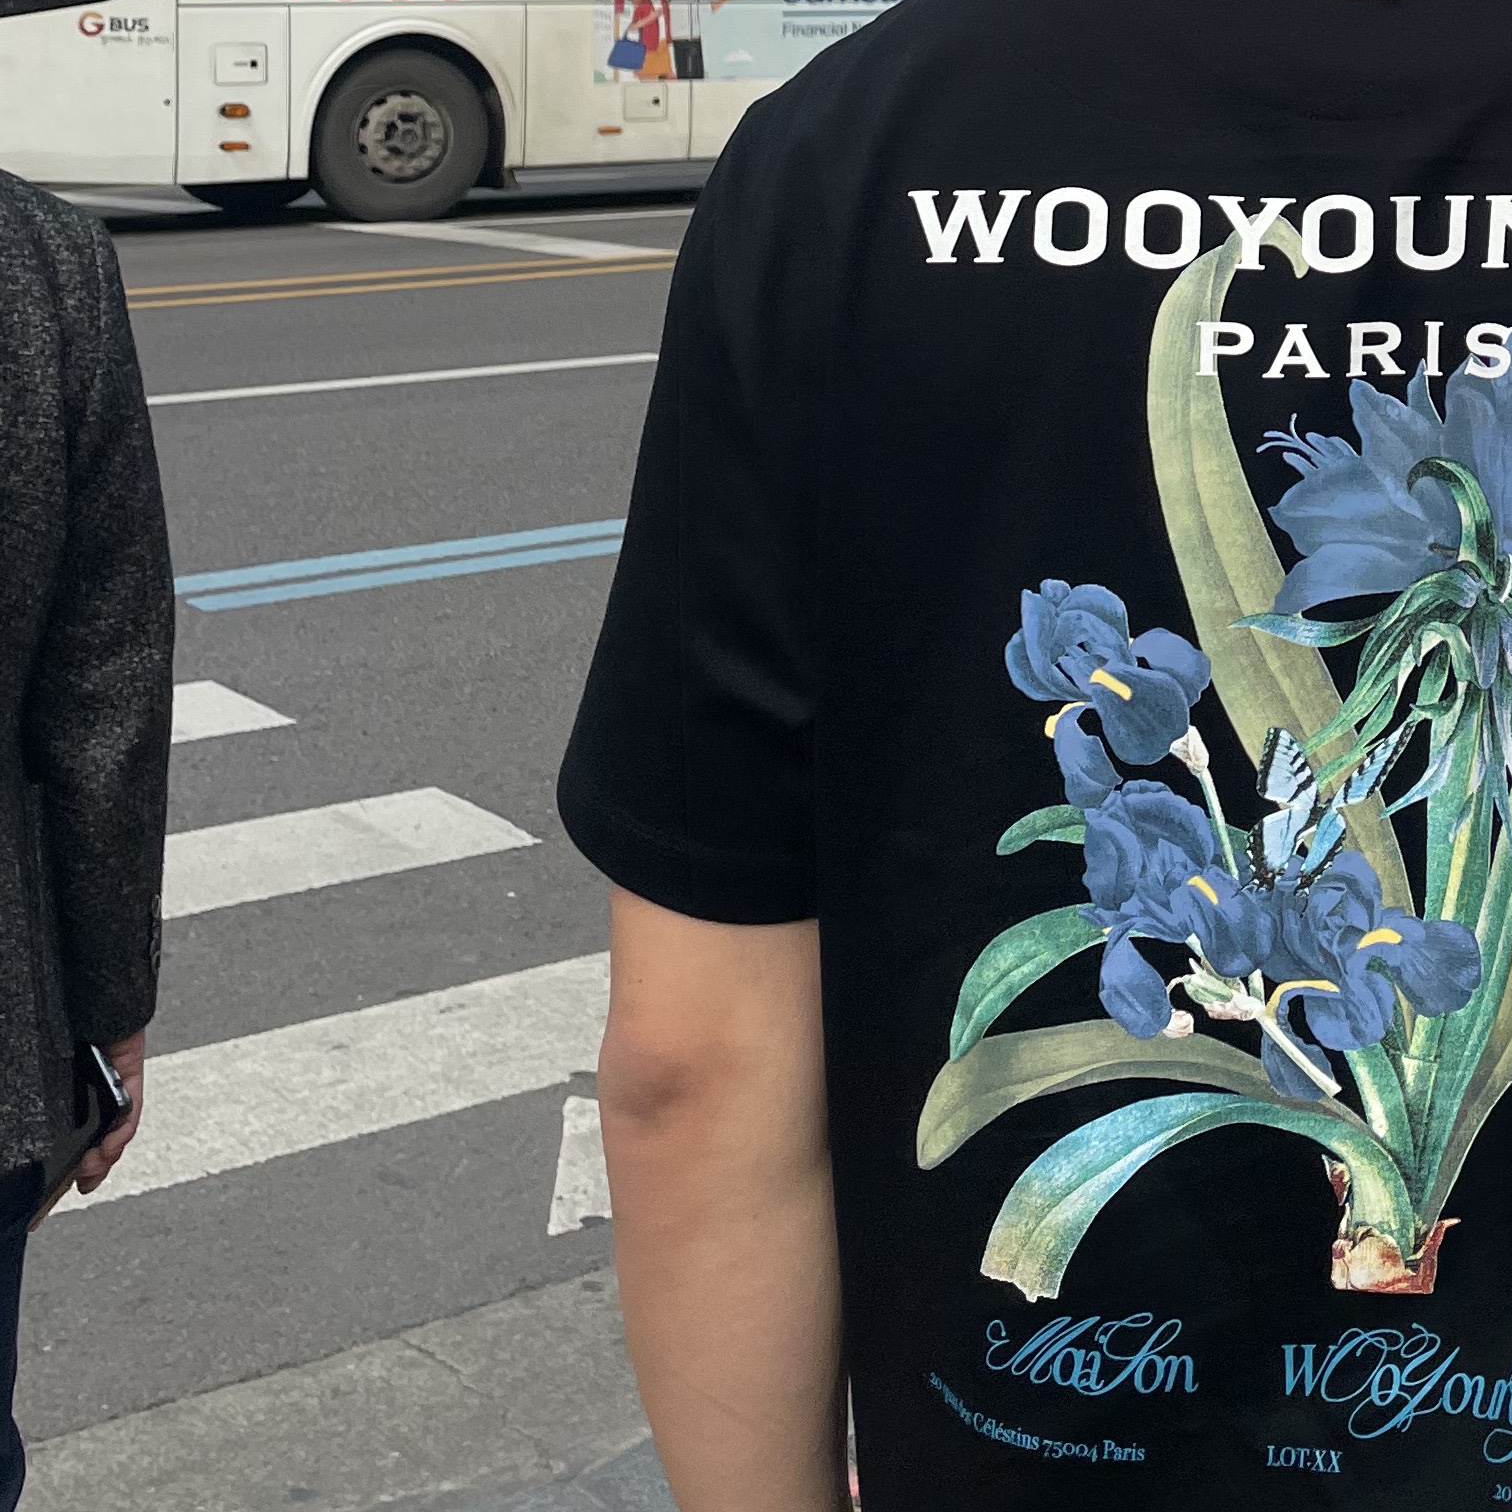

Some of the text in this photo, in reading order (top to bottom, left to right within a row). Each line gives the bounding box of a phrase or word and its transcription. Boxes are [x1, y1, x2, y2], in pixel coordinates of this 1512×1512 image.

[109, 17, 149, 32] BUS
[782, 21, 848, 38] Financial
[1043, 1439, 1099, 1463] 75004
[1102, 1439, 1147, 1462] Paris
[1492, 1484, 1512, 1503] 20
